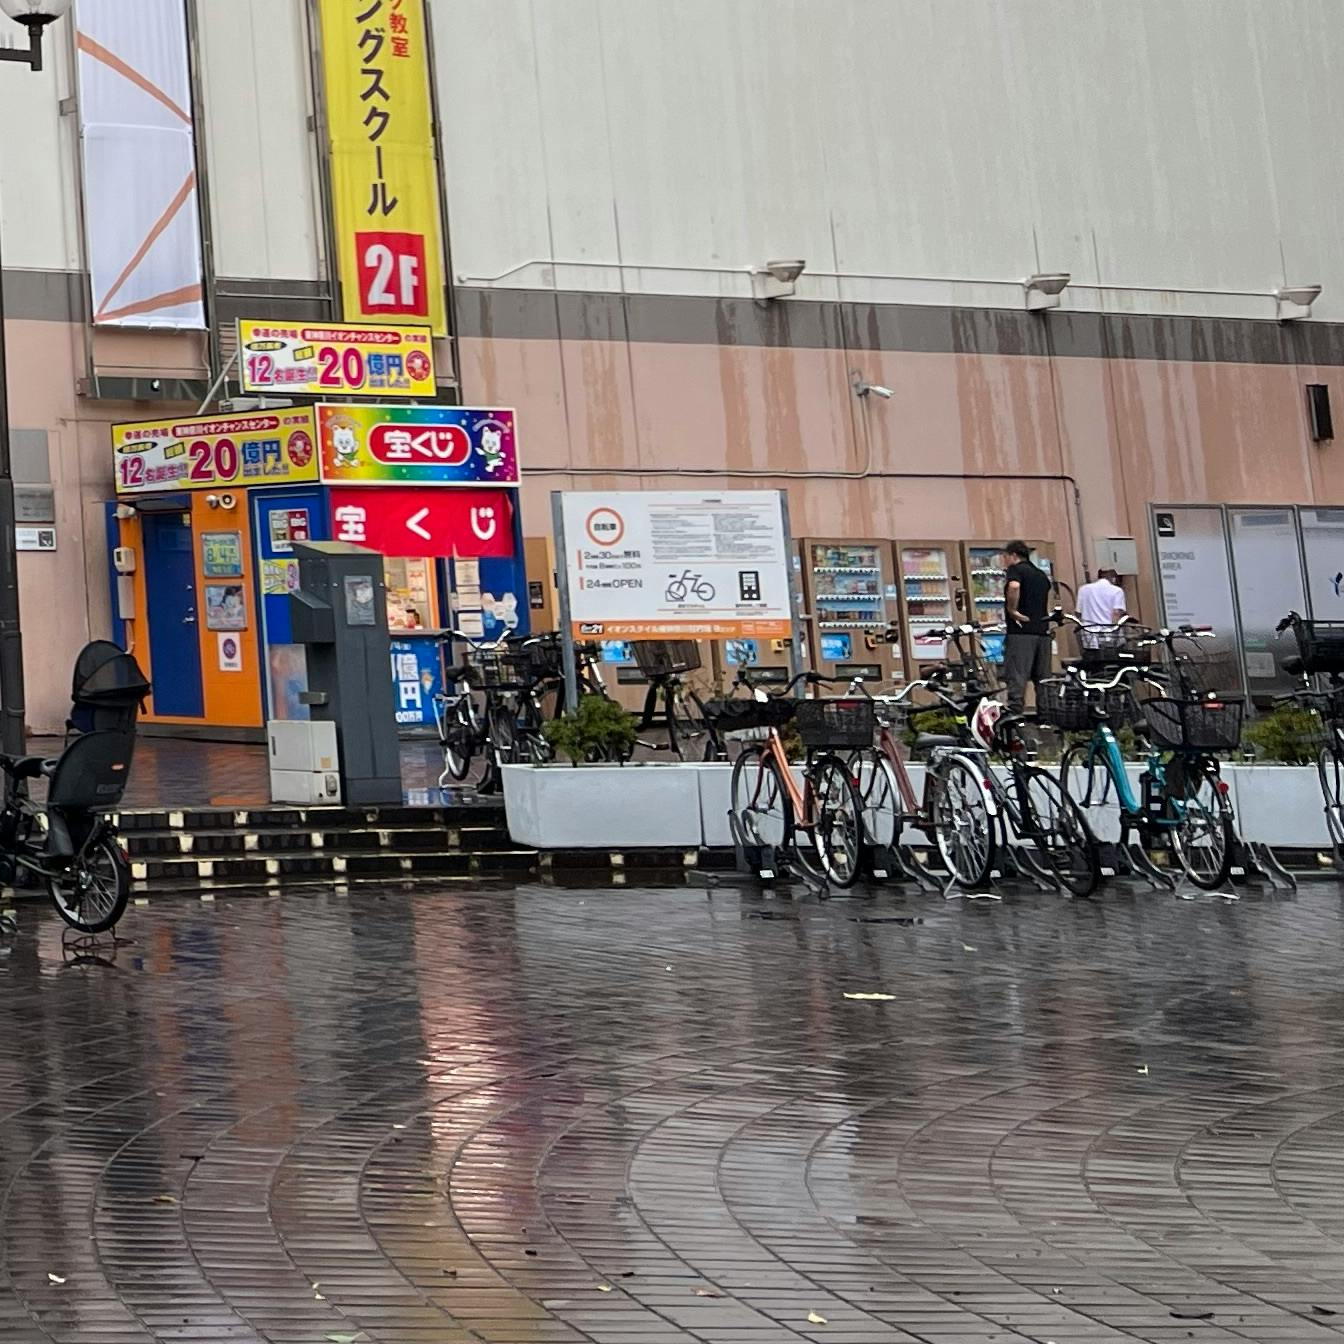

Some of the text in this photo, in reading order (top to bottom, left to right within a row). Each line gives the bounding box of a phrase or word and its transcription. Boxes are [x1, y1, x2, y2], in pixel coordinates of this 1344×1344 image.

[364, 244, 419, 306] 2F
[384, 430, 455, 458] 宝くじ
